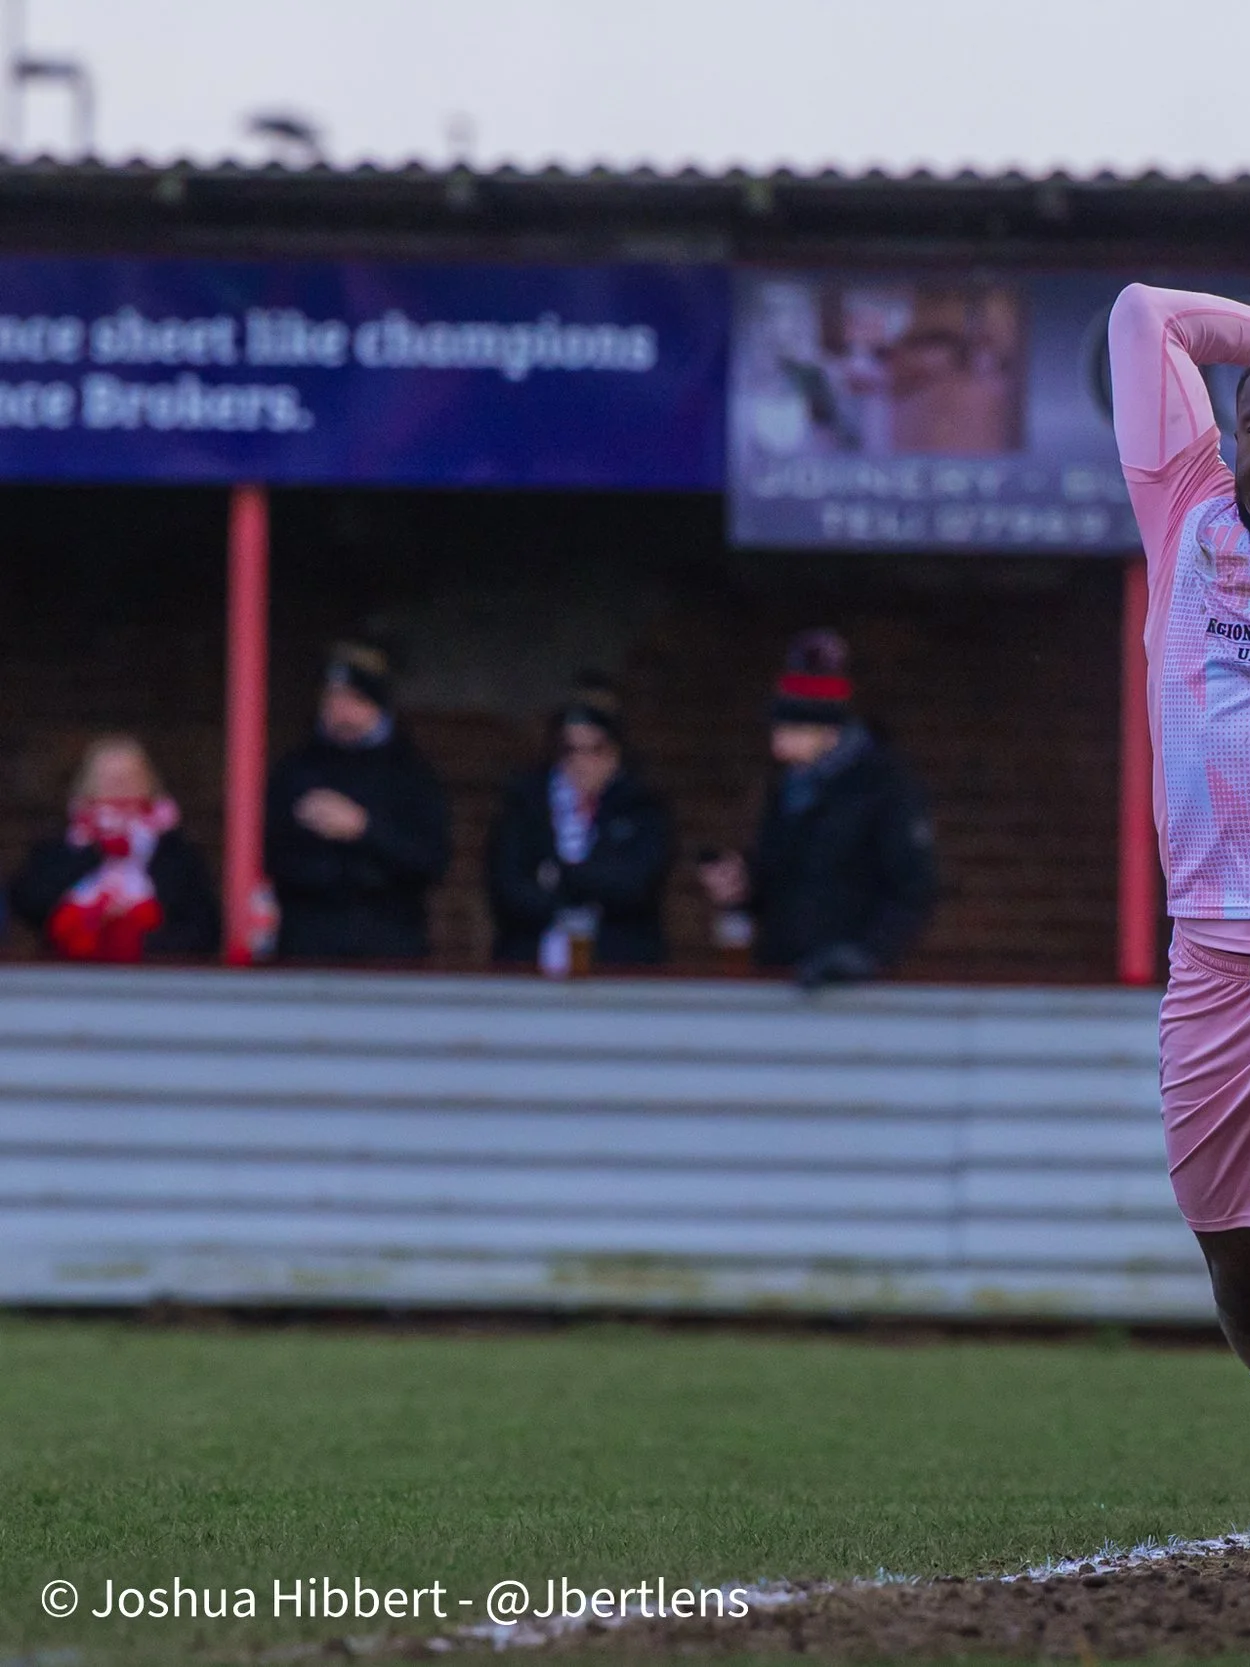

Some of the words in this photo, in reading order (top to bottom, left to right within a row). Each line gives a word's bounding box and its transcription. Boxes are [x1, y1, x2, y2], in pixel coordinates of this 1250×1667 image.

[90, 304, 238, 365] sheet
[245, 306, 350, 367] like
[354, 308, 659, 382] champions
[80, 371, 315, 432] Brokers.
